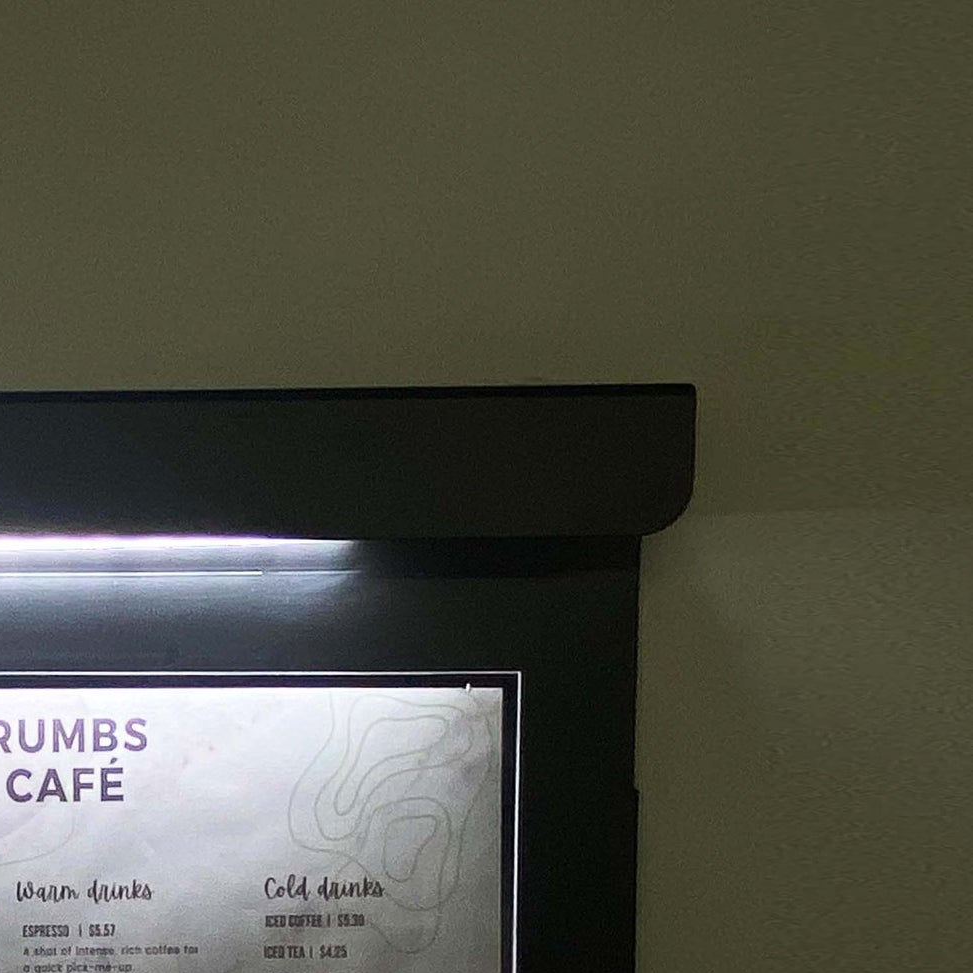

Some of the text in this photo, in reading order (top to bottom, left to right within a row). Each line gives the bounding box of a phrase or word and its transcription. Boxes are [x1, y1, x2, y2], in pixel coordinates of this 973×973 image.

[6, 758, 124, 803] CAFÉ
[16, 879, 154, 904] Warm drinks
[264, 874, 385, 901] Cold drinks
[265, 915, 286, 928] ICED
[288, 915, 322, 928] COFFEE
[22, 925, 69, 938] ESPRESSO
[264, 946, 285, 959] ICED
[287, 946, 305, 958] TEA
